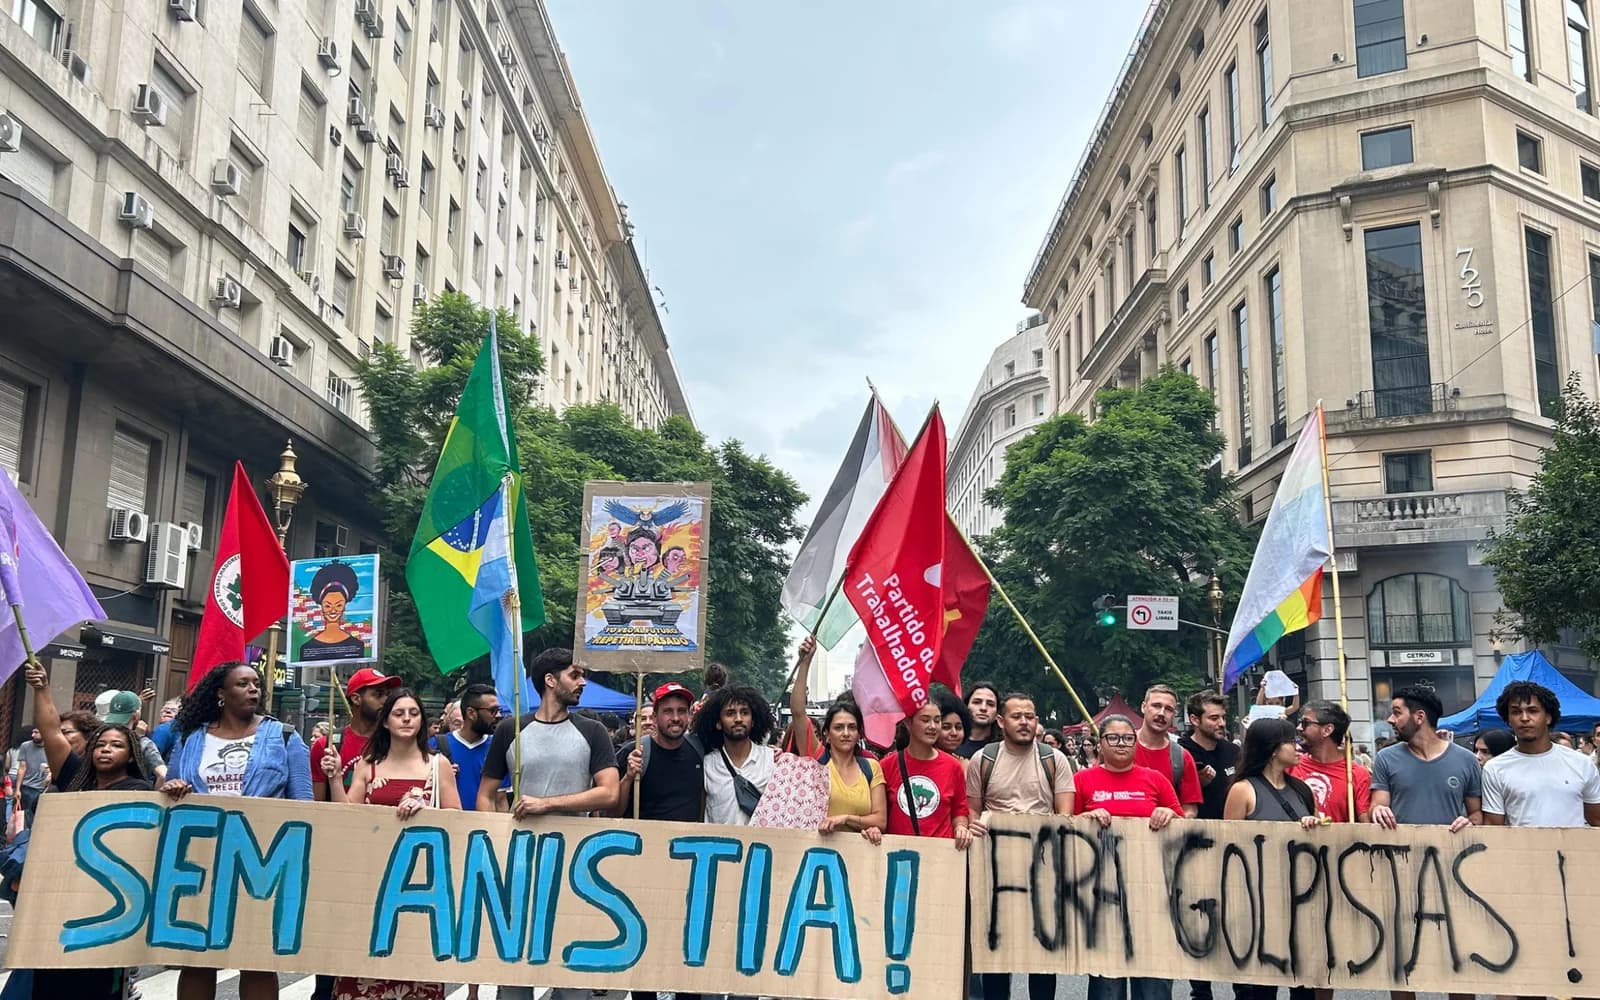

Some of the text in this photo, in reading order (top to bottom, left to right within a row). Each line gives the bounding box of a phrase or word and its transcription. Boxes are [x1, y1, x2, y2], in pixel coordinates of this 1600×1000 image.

[1455, 247, 1484, 309] 725
[592, 636, 689, 646] REPETIR EL PASADO
[645, 626, 678, 634] FUTURO
[855, 573, 929, 710] Trabalhadores
[883, 573, 926, 646] Partido
[206, 774, 245, 783] MARIE
[60, 802, 313, 956] SEM
[987, 826, 1135, 962] FORA
[1166, 832, 1519, 984] GOLPISTAS
